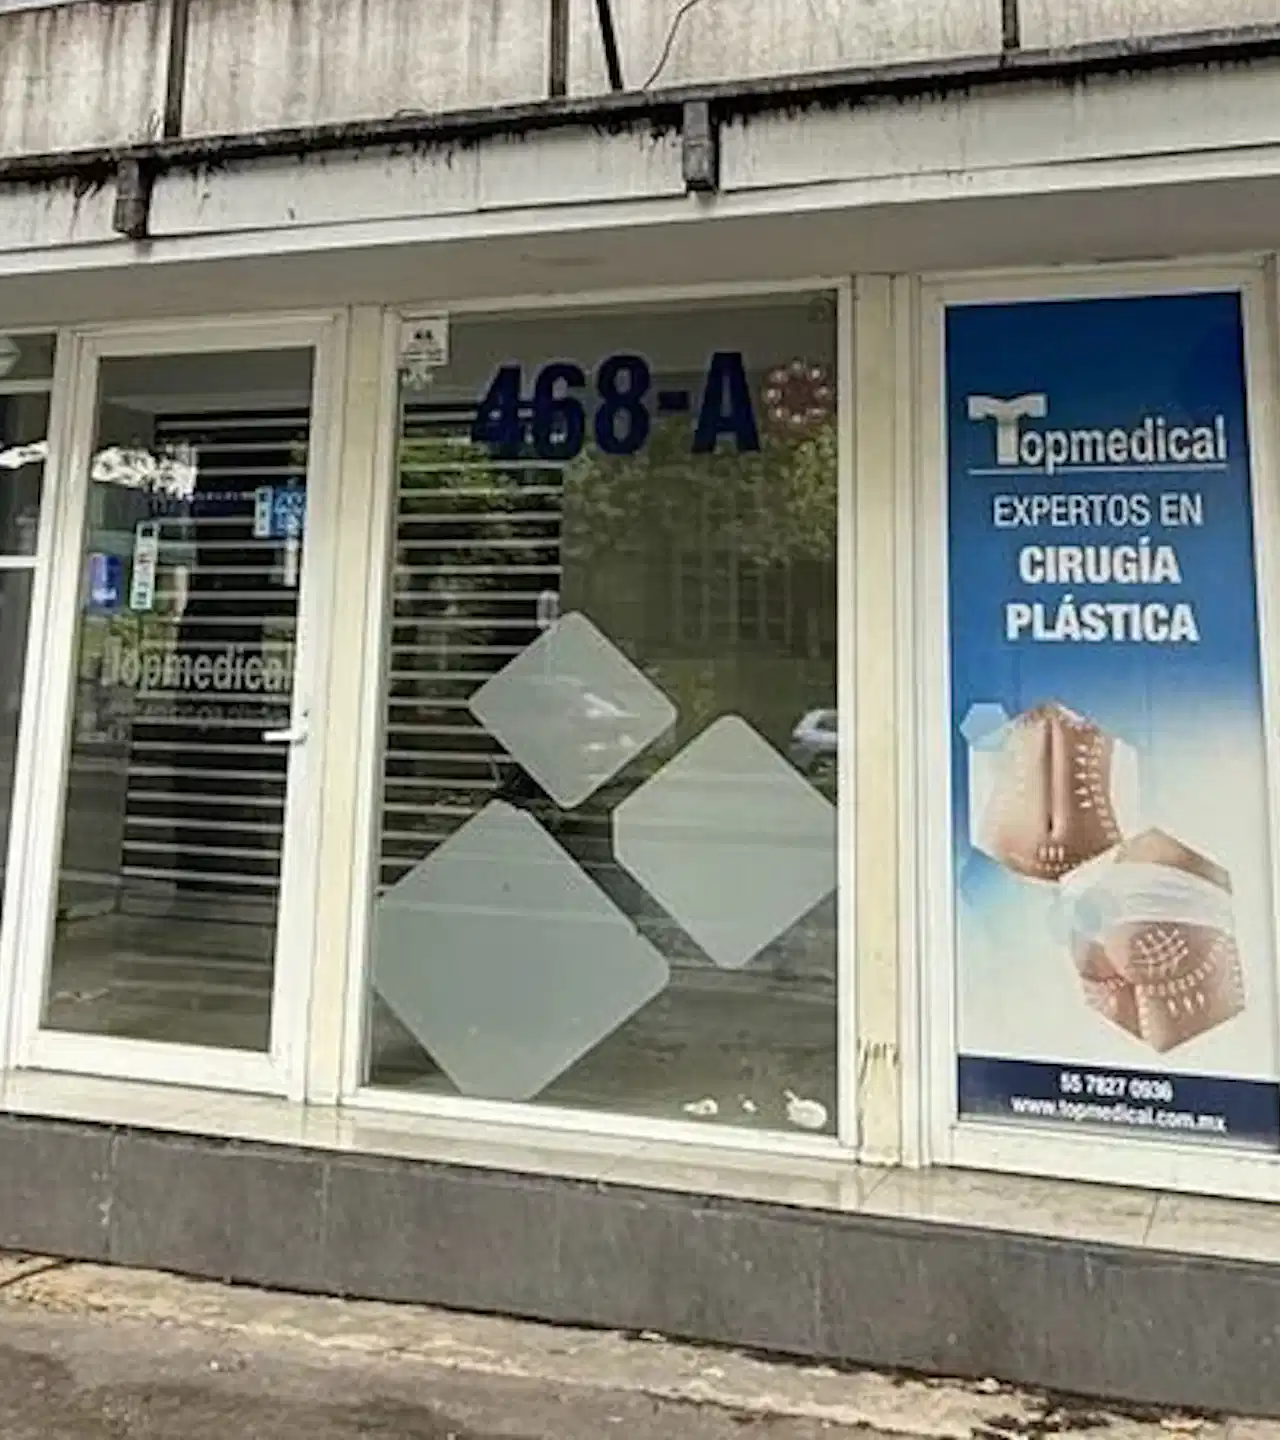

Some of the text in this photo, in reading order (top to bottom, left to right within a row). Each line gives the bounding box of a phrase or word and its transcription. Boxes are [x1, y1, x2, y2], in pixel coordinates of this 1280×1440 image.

[471, 351, 761, 458] 468-A
[967, 394, 1228, 475] Topmedical
[993, 491, 1204, 528] EXPERTOS EN
[1019, 535, 1182, 585] CIRUGÍA
[1006, 593, 1200, 642] PLÁSTICA
